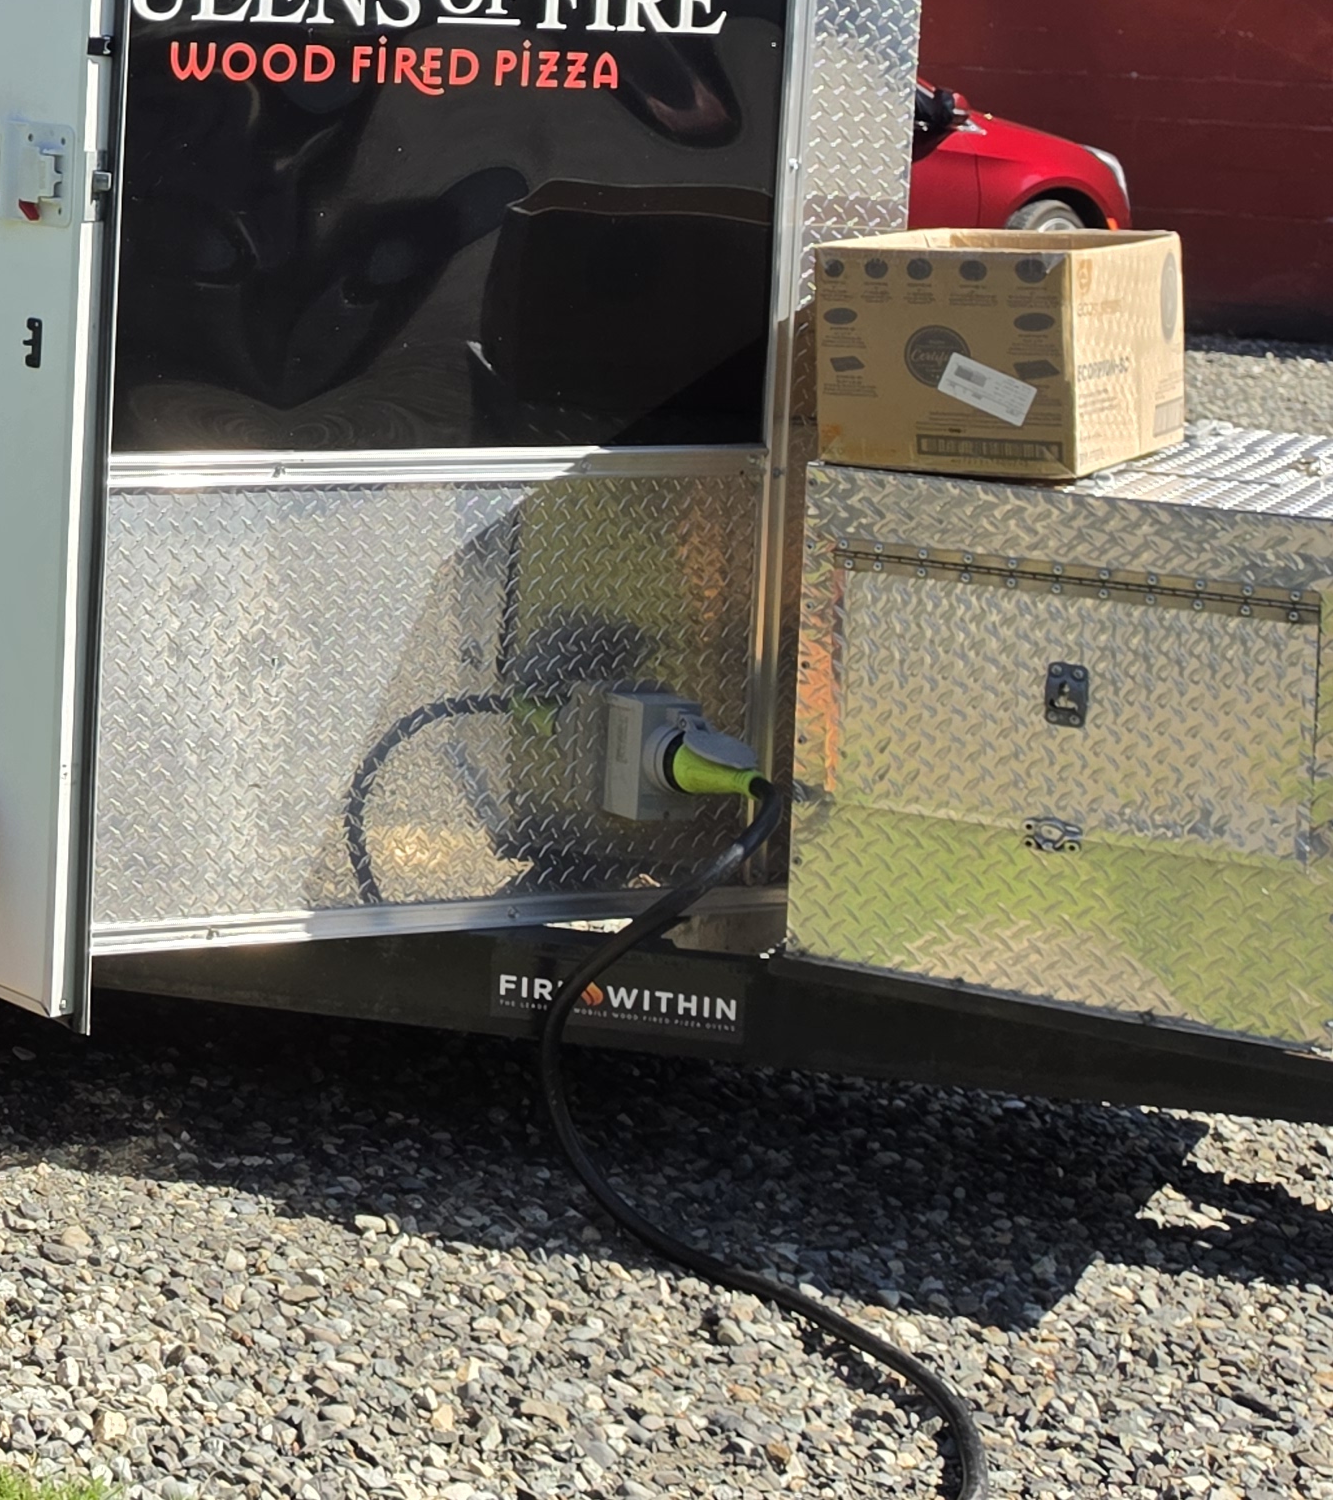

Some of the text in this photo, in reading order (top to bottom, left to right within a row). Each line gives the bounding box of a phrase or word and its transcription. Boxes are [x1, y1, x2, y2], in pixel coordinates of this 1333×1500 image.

[169, 40, 335, 82] WOOD
[494, 39, 620, 90] PIZZA
[499, 973, 737, 1022] FIR WITHIN
